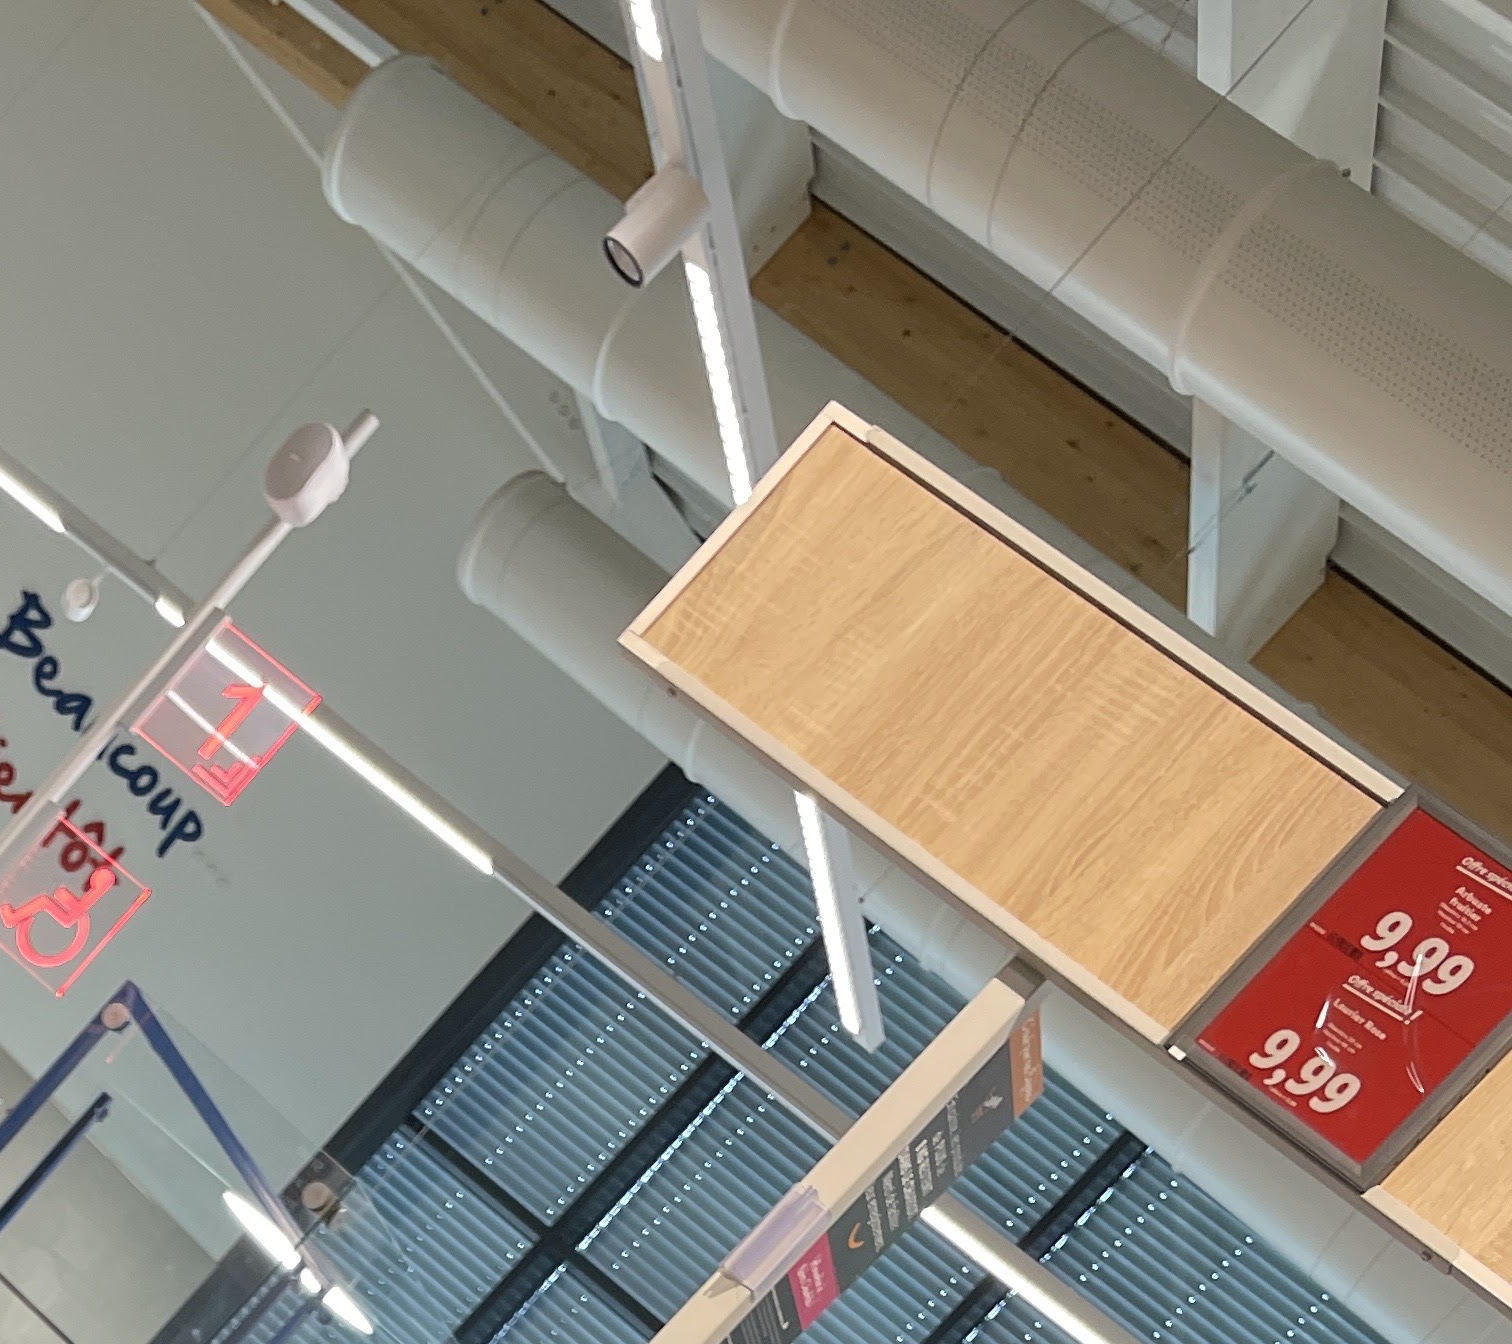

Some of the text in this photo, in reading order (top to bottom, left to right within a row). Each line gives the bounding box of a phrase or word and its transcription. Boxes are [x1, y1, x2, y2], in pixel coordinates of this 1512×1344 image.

[221, 682, 269, 760] 1
[1360, 911, 1474, 995] 9,99
[1248, 1029, 1361, 1114] 9,99
